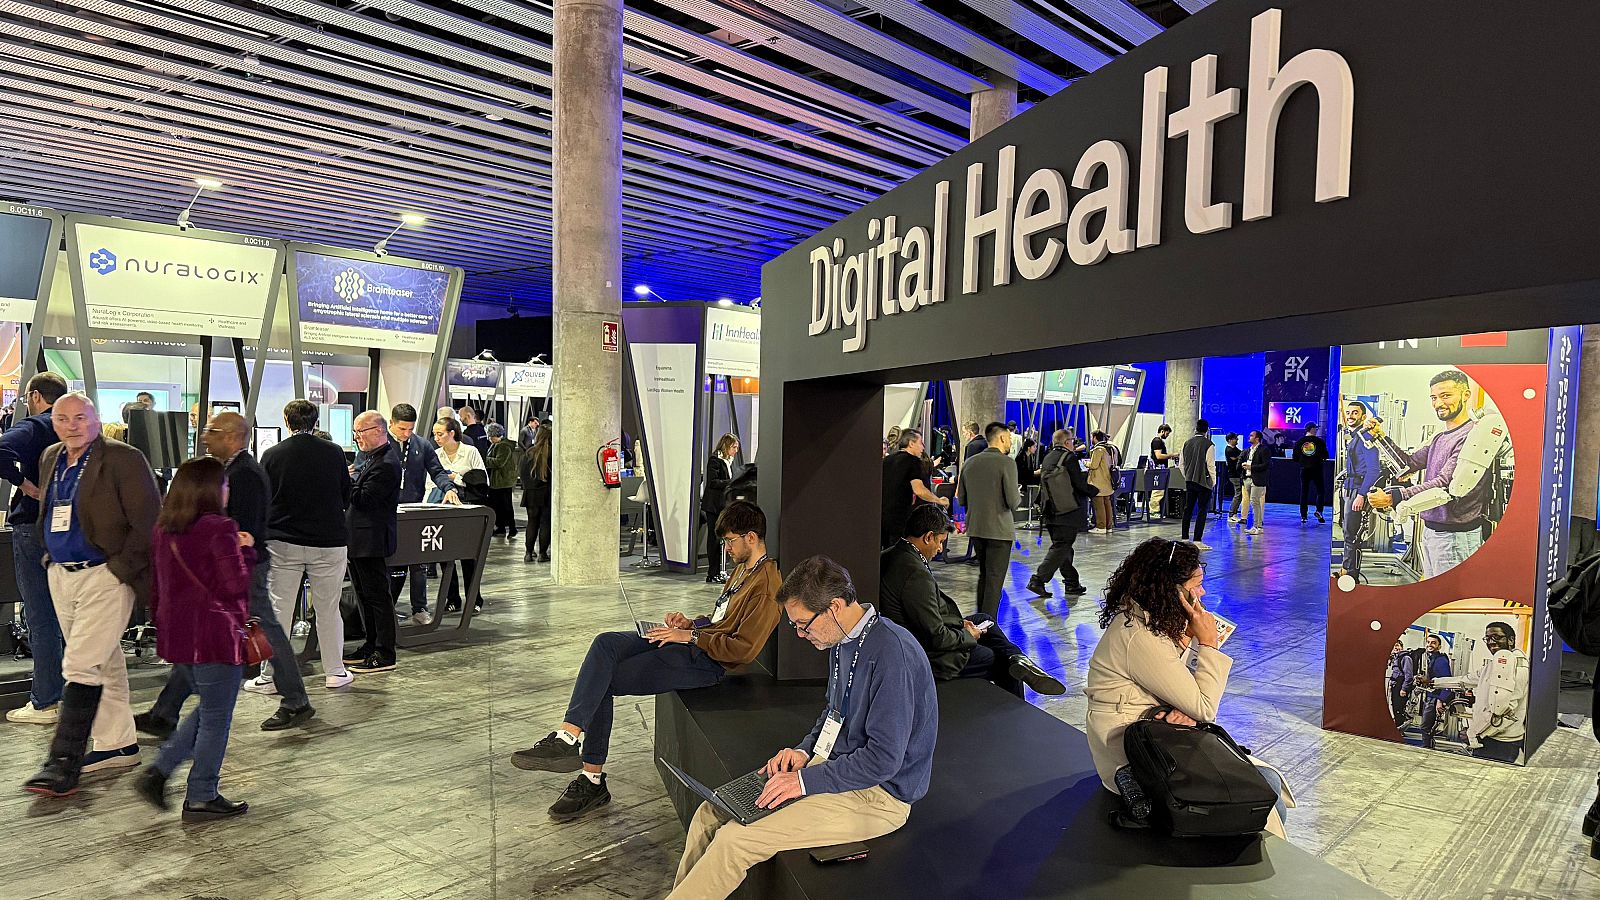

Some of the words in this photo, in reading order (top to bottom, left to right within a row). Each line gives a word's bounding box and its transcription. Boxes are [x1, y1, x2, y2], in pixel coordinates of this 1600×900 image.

[808, 179, 950, 352] Digital
[962, 7, 1355, 295] Health
[367, 283, 414, 298] Brainteaser
[1284, 356, 1310, 369] 4Y
[1284, 368, 1309, 381] FN
[1285, 406, 1302, 415] 4Y
[1557, 337, 1572, 488] AI-powered
[1285, 415, 1301, 424] FN
[1553, 380, 1564, 476] Patient
[421, 524, 444, 538] 4Y
[421, 537, 443, 552] FN
